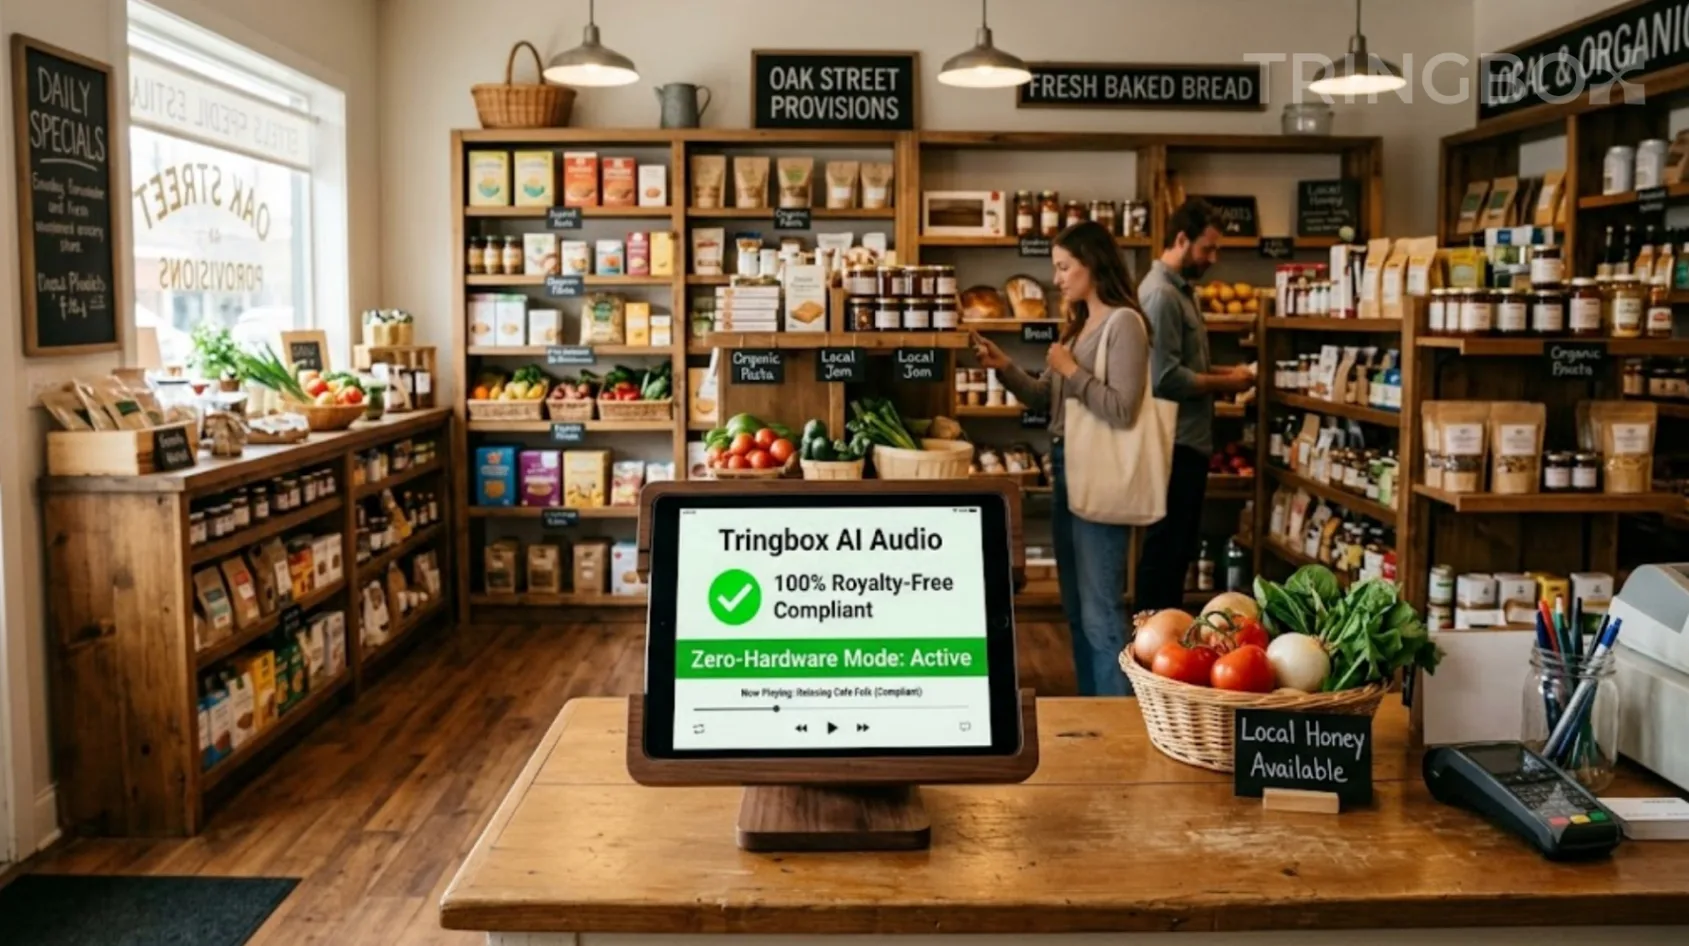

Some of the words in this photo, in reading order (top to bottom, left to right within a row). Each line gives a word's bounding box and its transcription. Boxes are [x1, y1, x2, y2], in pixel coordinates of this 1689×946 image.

[769, 66, 815, 91] OAK
[820, 66, 900, 91] STREET
[1029, 74, 1098, 99] FRESH
[1105, 74, 1175, 99] BAKED
[1182, 75, 1254, 100] BREAD
[1487, 53, 1549, 108] LOCAL
[1556, 44, 1571, 87] &
[37, 65, 91, 117] DAILY
[771, 95, 900, 120] PROVISIONS
[30, 110, 105, 163] SPECIALS
[821, 350, 855, 363] Local
[898, 350, 934, 363] Local
[719, 527, 829, 556] Tringbox
[836, 529, 862, 551] AI
[870, 527, 943, 551] Audio
[774, 574, 826, 592] 100%
[832, 572, 954, 595] Royalty-Free
[773, 600, 874, 622] Compliant
[690, 649, 838, 668] Zero-Hardware
[844, 649, 905, 668] Mode:
[910, 648, 972, 667] Active
[1241, 716, 1295, 744] Local
[1306, 720, 1365, 761] Honey
[1250, 751, 1349, 783] Available
